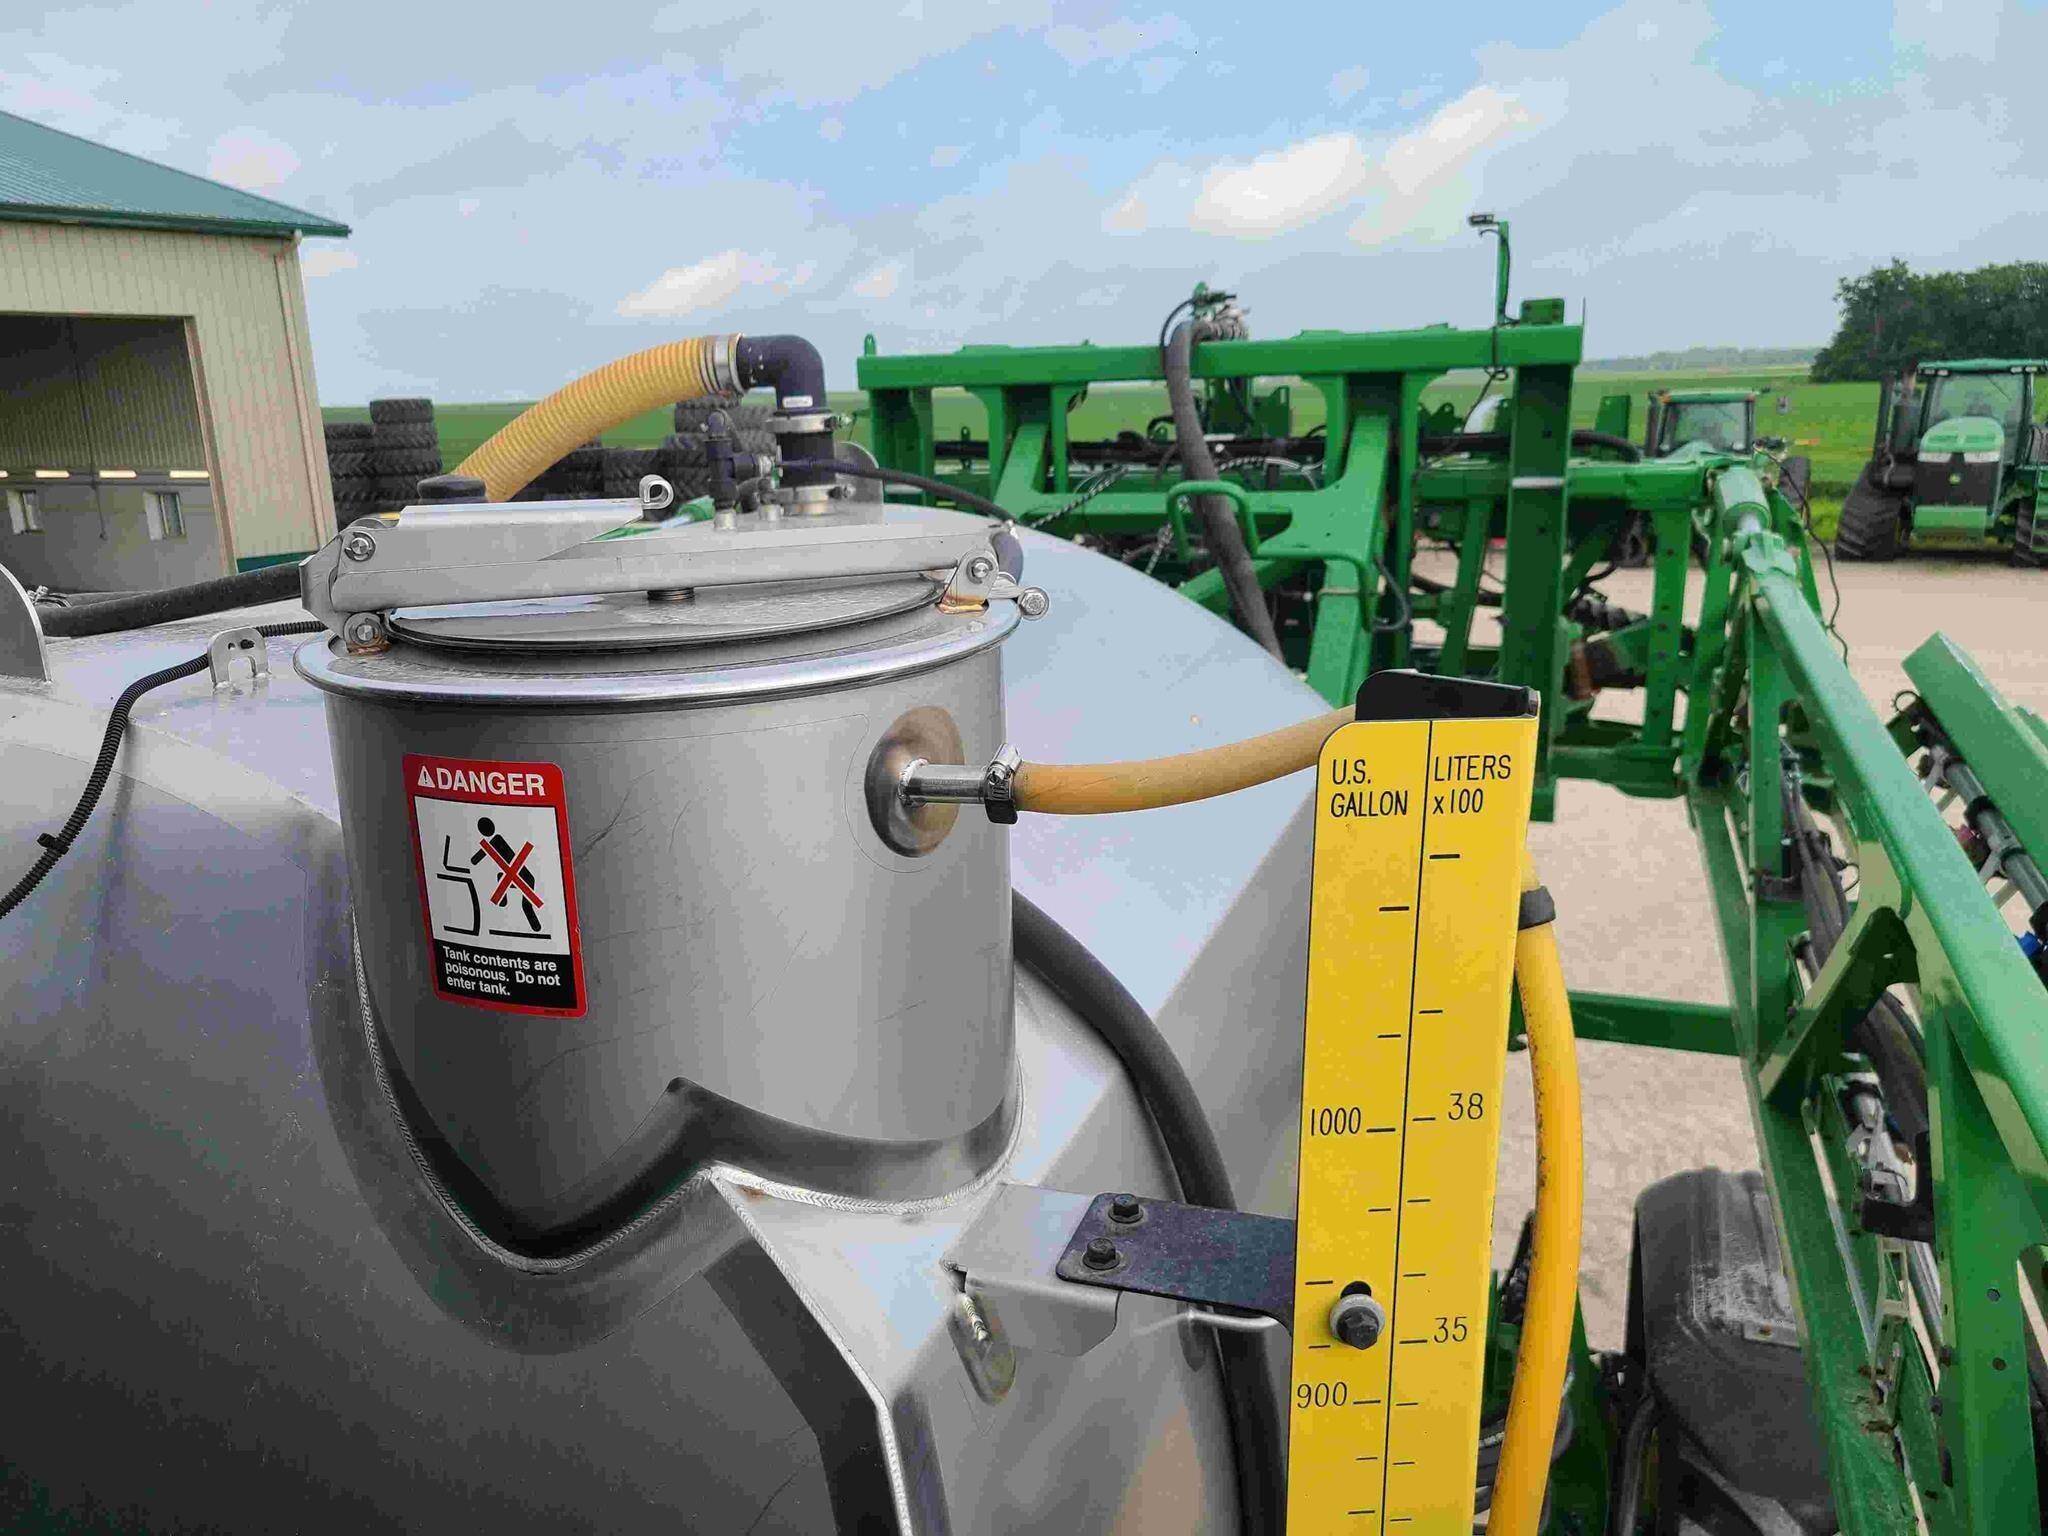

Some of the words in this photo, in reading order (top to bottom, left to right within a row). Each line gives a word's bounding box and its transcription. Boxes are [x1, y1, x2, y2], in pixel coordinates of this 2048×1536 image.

[436, 767, 546, 797] DANGER
[1332, 759, 1371, 785] U.S.
[1434, 754, 1512, 782] LITERS
[1331, 790, 1409, 818] GALLON
[1432, 787, 1484, 815] x100
[443, 945, 471, 962] Tank
[473, 952, 530, 970] contents
[534, 959, 557, 972] are
[445, 962, 509, 982] poisonous.
[515, 971, 534, 985] Do
[537, 973, 560, 986] not
[447, 974, 477, 992] enter
[479, 979, 511, 996] tank.
[1447, 1092, 1484, 1120] 38
[1310, 1107, 1362, 1137] 1000
[1433, 1316, 1468, 1344] 35
[1296, 1381, 1348, 1409] 900
